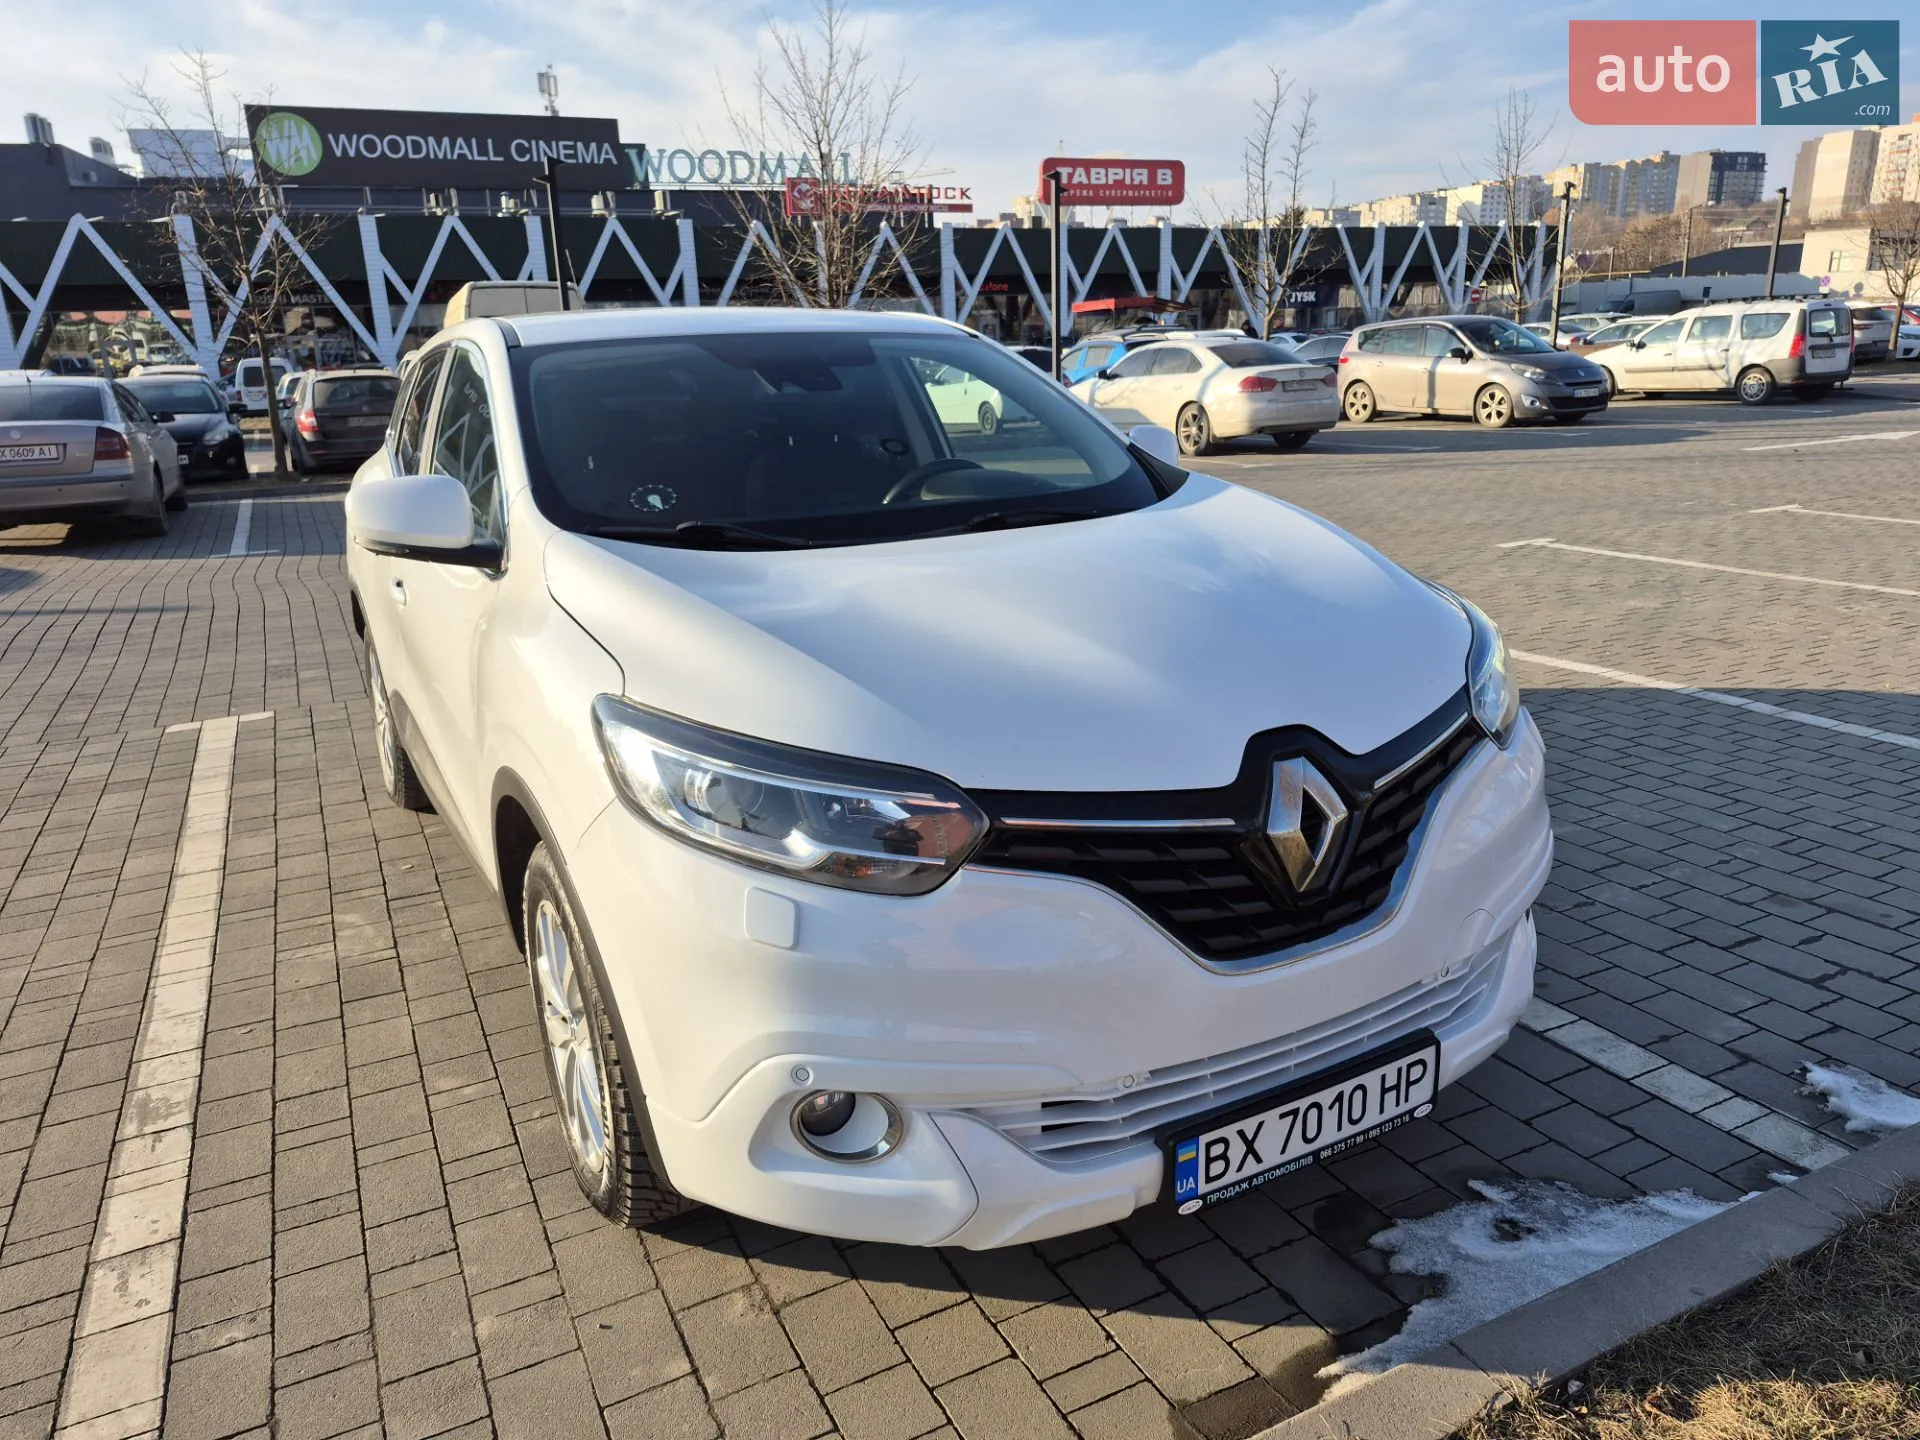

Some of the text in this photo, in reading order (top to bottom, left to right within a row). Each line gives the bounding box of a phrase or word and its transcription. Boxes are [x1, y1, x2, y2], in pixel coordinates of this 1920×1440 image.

[328, 132, 618, 165] WOODMALL CINEMA
[1056, 166, 1173, 185] ТАВРІЯ В
[1290, 290, 1317, 302] JYSK
[9, 447, 35, 458] 0609
[1205, 1058, 1428, 1185] BX 7010 HP
[1333, 1142, 1346, 1154] 375
[1346, 1138, 1355, 1148] 77
[1368, 1127, 1381, 1139] 095
[1381, 1123, 1393, 1133] 123
[1393, 1118, 1401, 1128] 73
[1177, 1176, 1196, 1194] UA
[1207, 1155, 1314, 1204] ПРОДАЖ АВТОМОБІЛІВ
